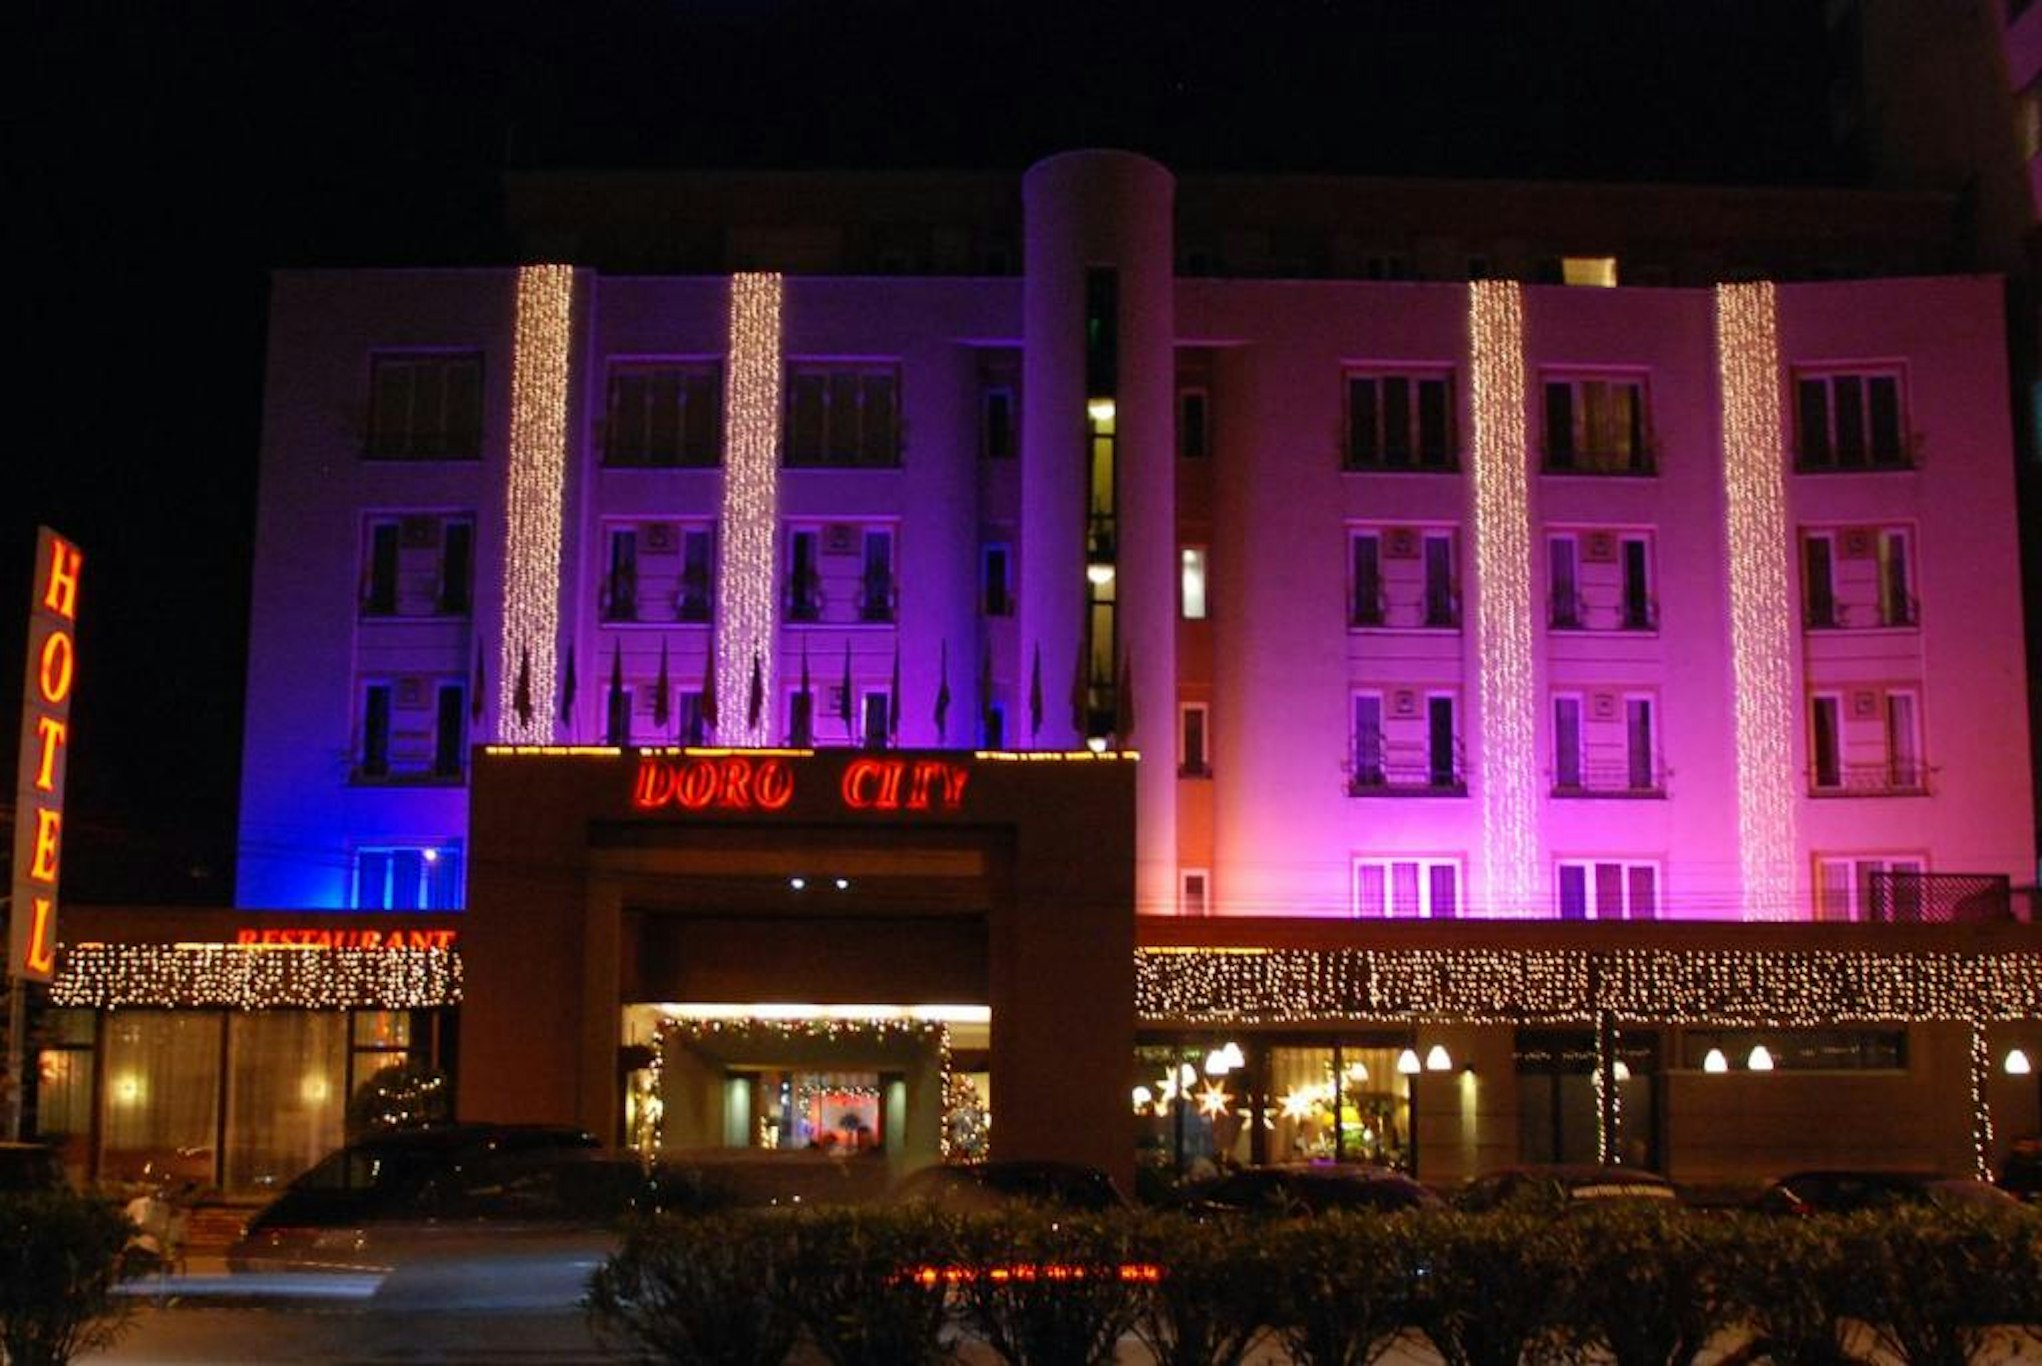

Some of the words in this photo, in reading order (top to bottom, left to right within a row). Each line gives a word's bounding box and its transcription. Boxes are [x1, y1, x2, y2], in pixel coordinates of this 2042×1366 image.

[28, 540, 82, 974] HOTEL
[841, 759, 968, 810] CITY
[237, 930, 456, 951] RESTAURANT
